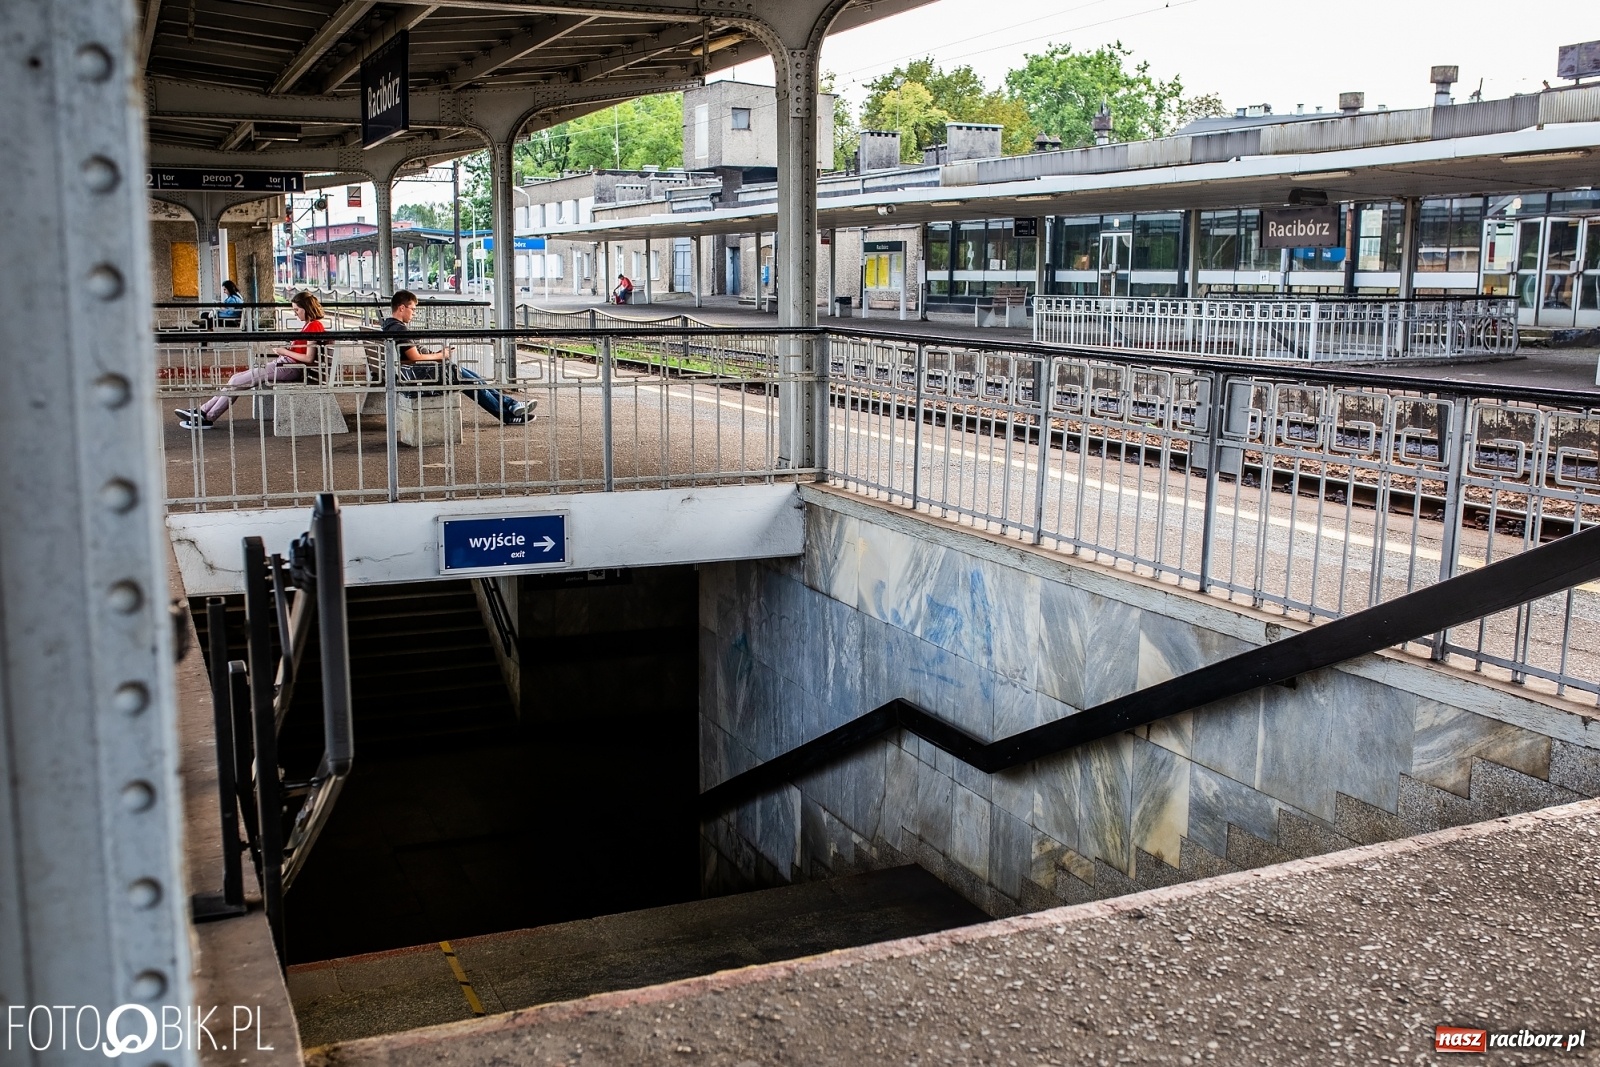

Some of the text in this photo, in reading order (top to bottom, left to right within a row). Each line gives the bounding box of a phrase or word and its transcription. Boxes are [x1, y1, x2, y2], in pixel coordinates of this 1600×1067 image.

[367, 72, 401, 120] Racibórz
[145, 173, 154, 186] 2
[162, 173, 175, 181] tor
[202, 173, 232, 183] peron
[234, 173, 245, 188] 2
[290, 177, 297, 190] 1
[1268, 219, 1330, 237] Racibórz
[468, 532, 526, 551] wyjście
[510, 550, 526, 559] exit
